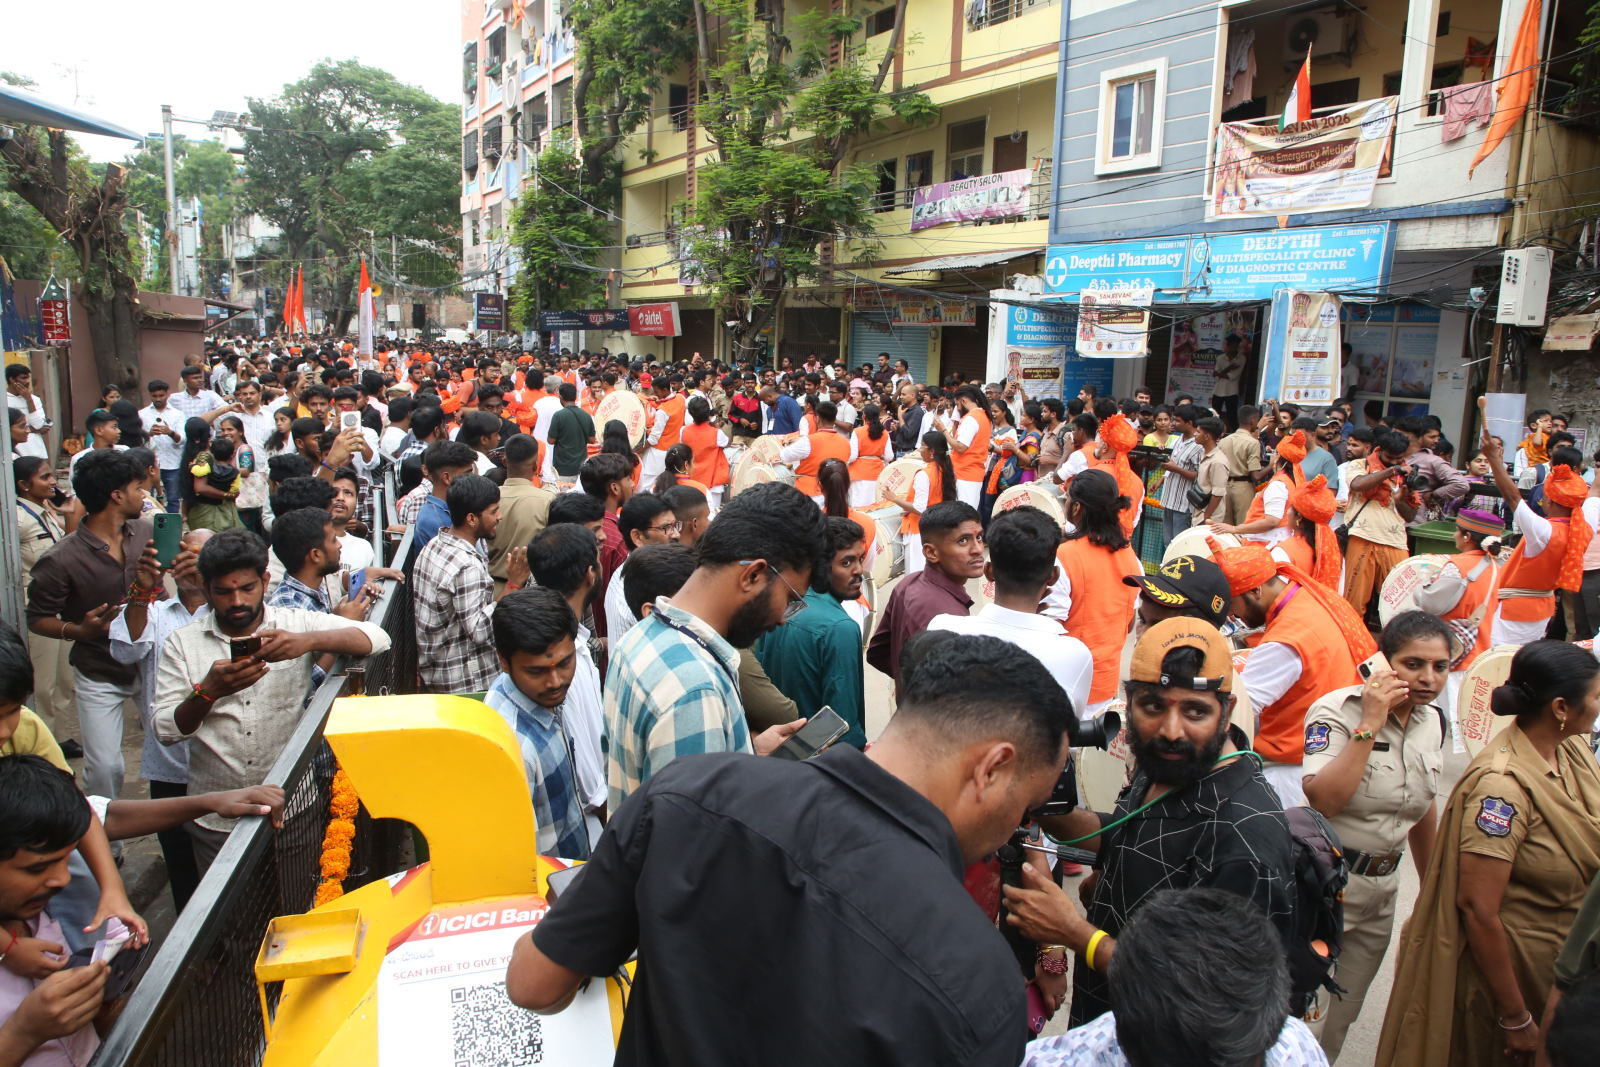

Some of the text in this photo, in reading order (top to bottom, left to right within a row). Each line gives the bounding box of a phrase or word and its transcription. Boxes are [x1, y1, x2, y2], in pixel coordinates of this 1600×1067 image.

[1259, 119, 1319, 137] SANEEVANI
[1321, 113, 1351, 129] 2026
[1276, 149, 1320, 163] Emergency
[949, 174, 1003, 193] BEAUTY SALON
[1242, 232, 1323, 251] DEEPTHI
[1070, 252, 1183, 271] Deepthi Pharmacy
[1211, 248, 1357, 263] MULTISPECIALITY CLINIC
[1216, 260, 1347, 274] & DIAGNOSTIC CENTRE
[645, 310, 663, 325] airtel
[1481, 812, 1509, 827] POLICE
[439, 910, 498, 934] ICICI
[392, 955, 513, 980] SCAN HERE TO GIVE YO
